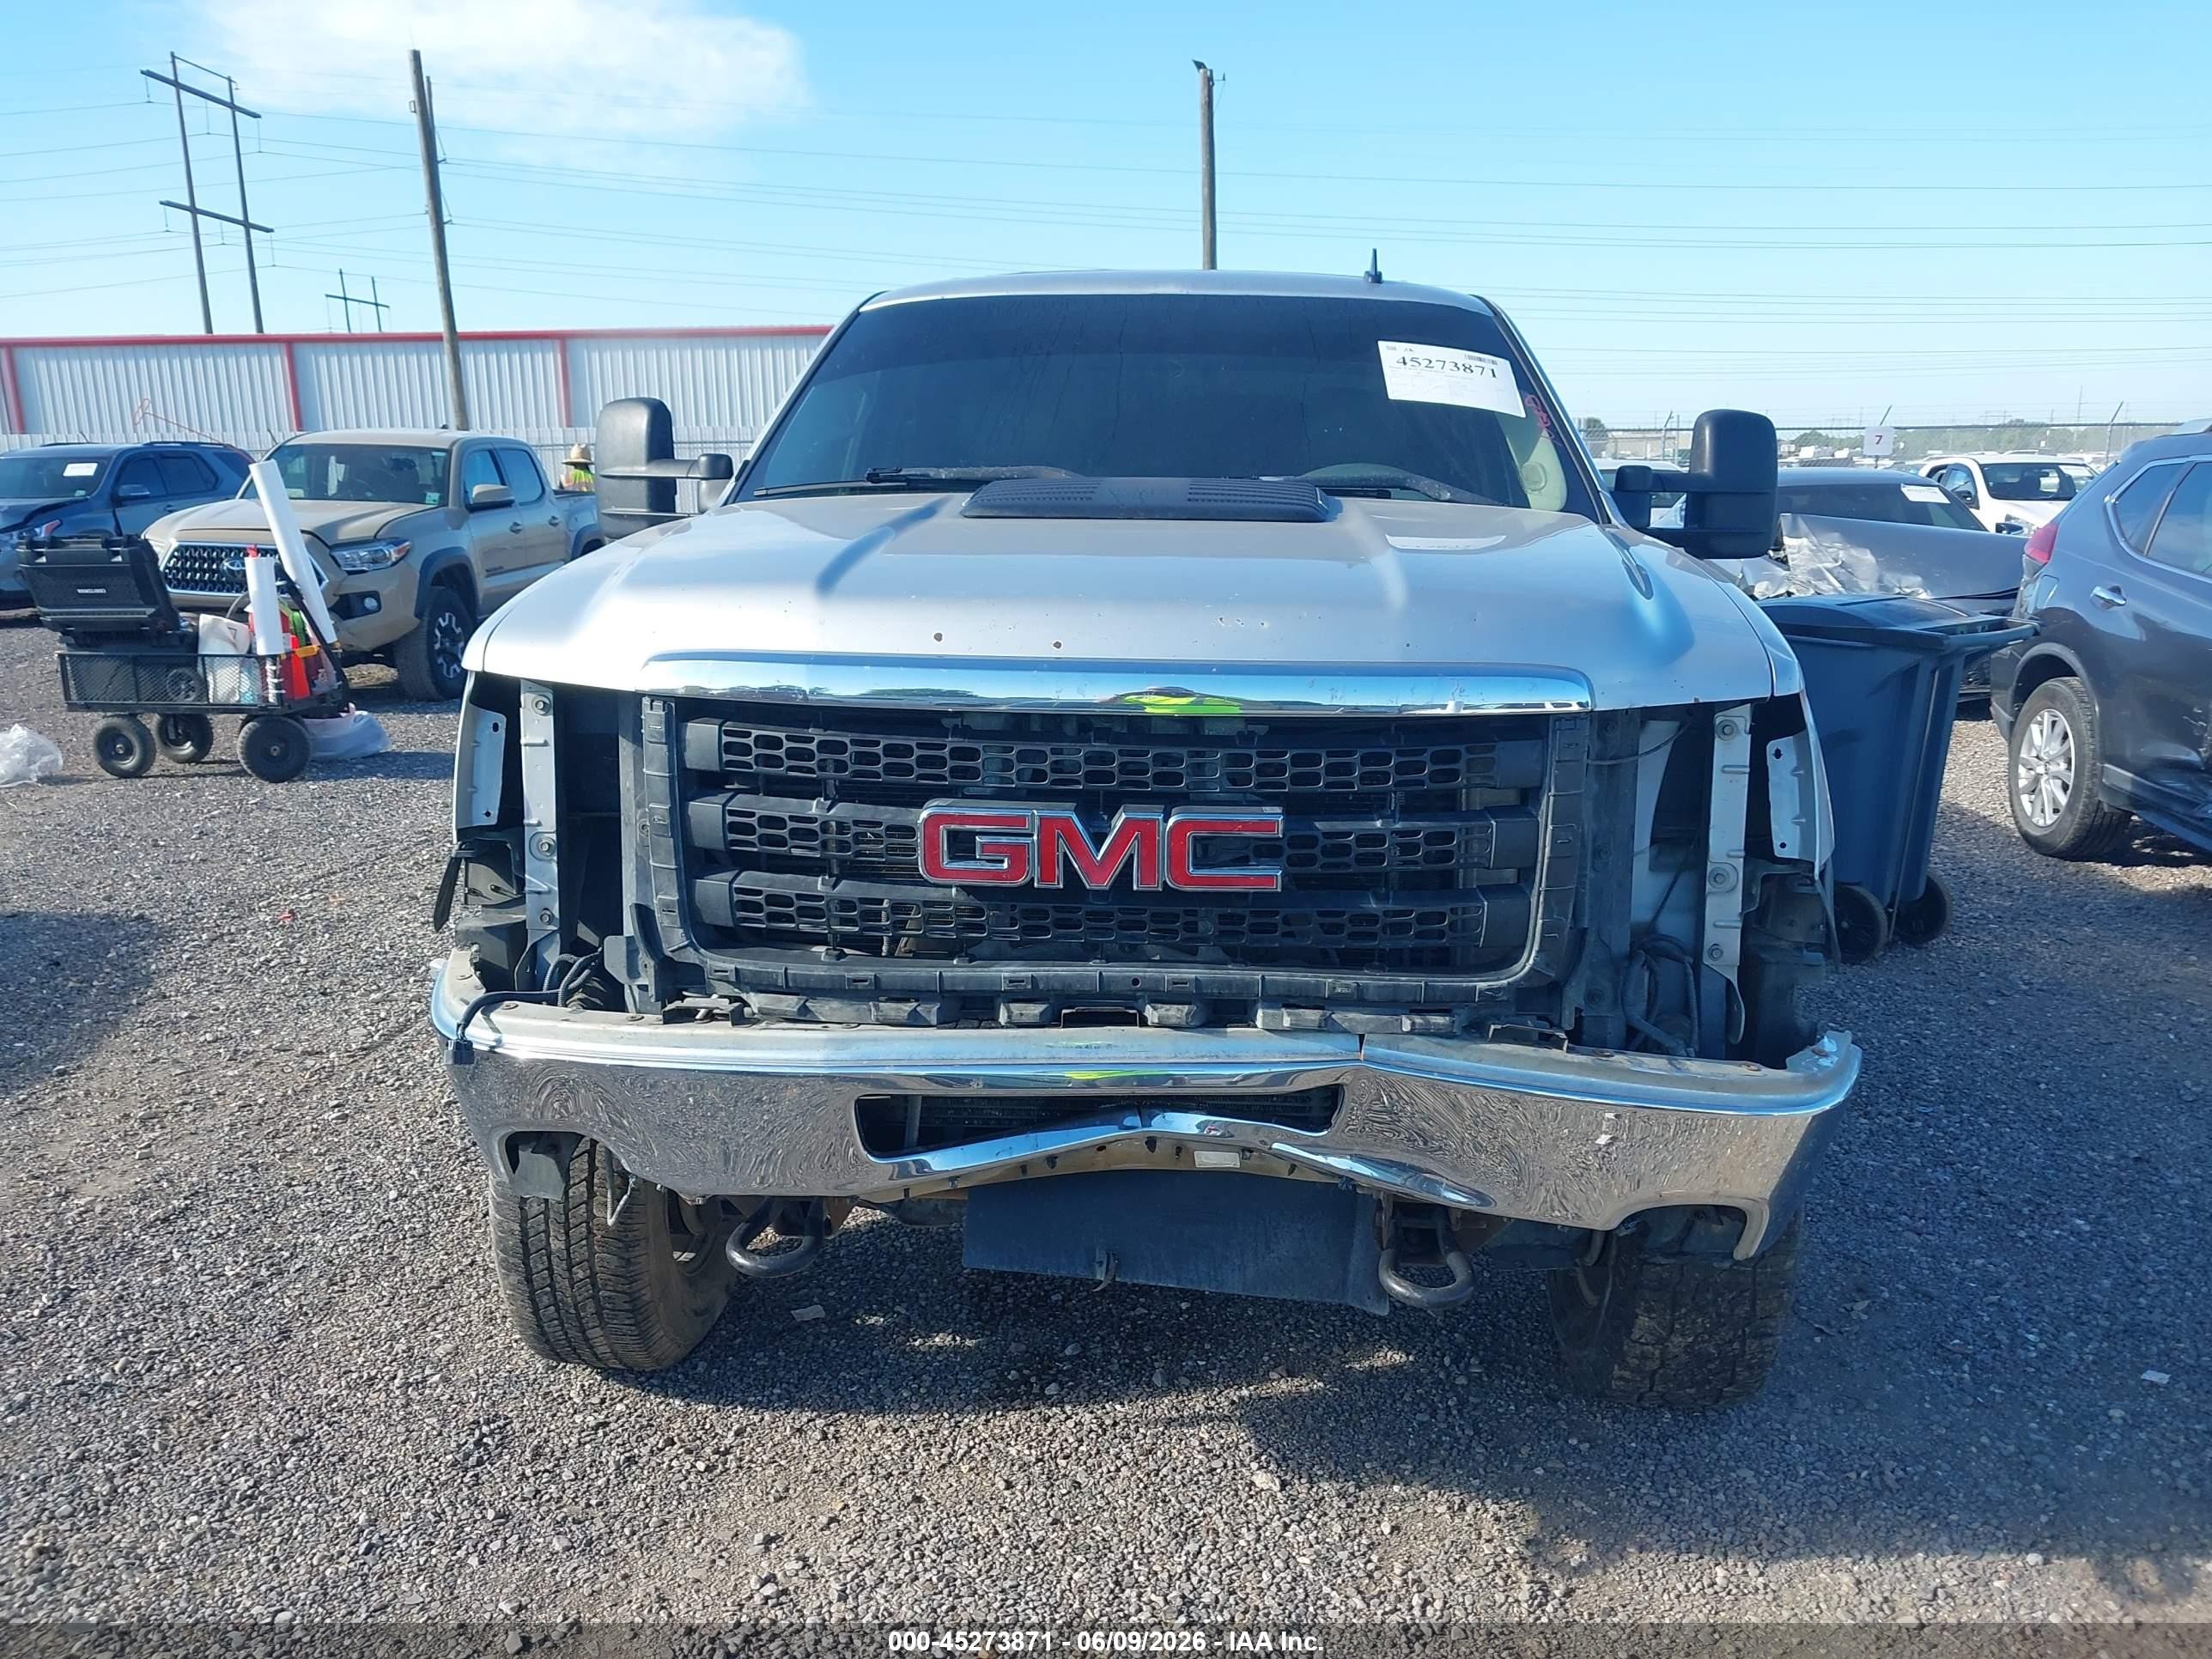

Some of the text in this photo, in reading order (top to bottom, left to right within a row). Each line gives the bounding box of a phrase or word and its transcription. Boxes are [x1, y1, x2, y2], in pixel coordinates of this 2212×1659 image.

[1396, 356, 1498, 379] 45273871
[1875, 434, 1883, 445] 7
[918, 802, 1284, 892] GMC
